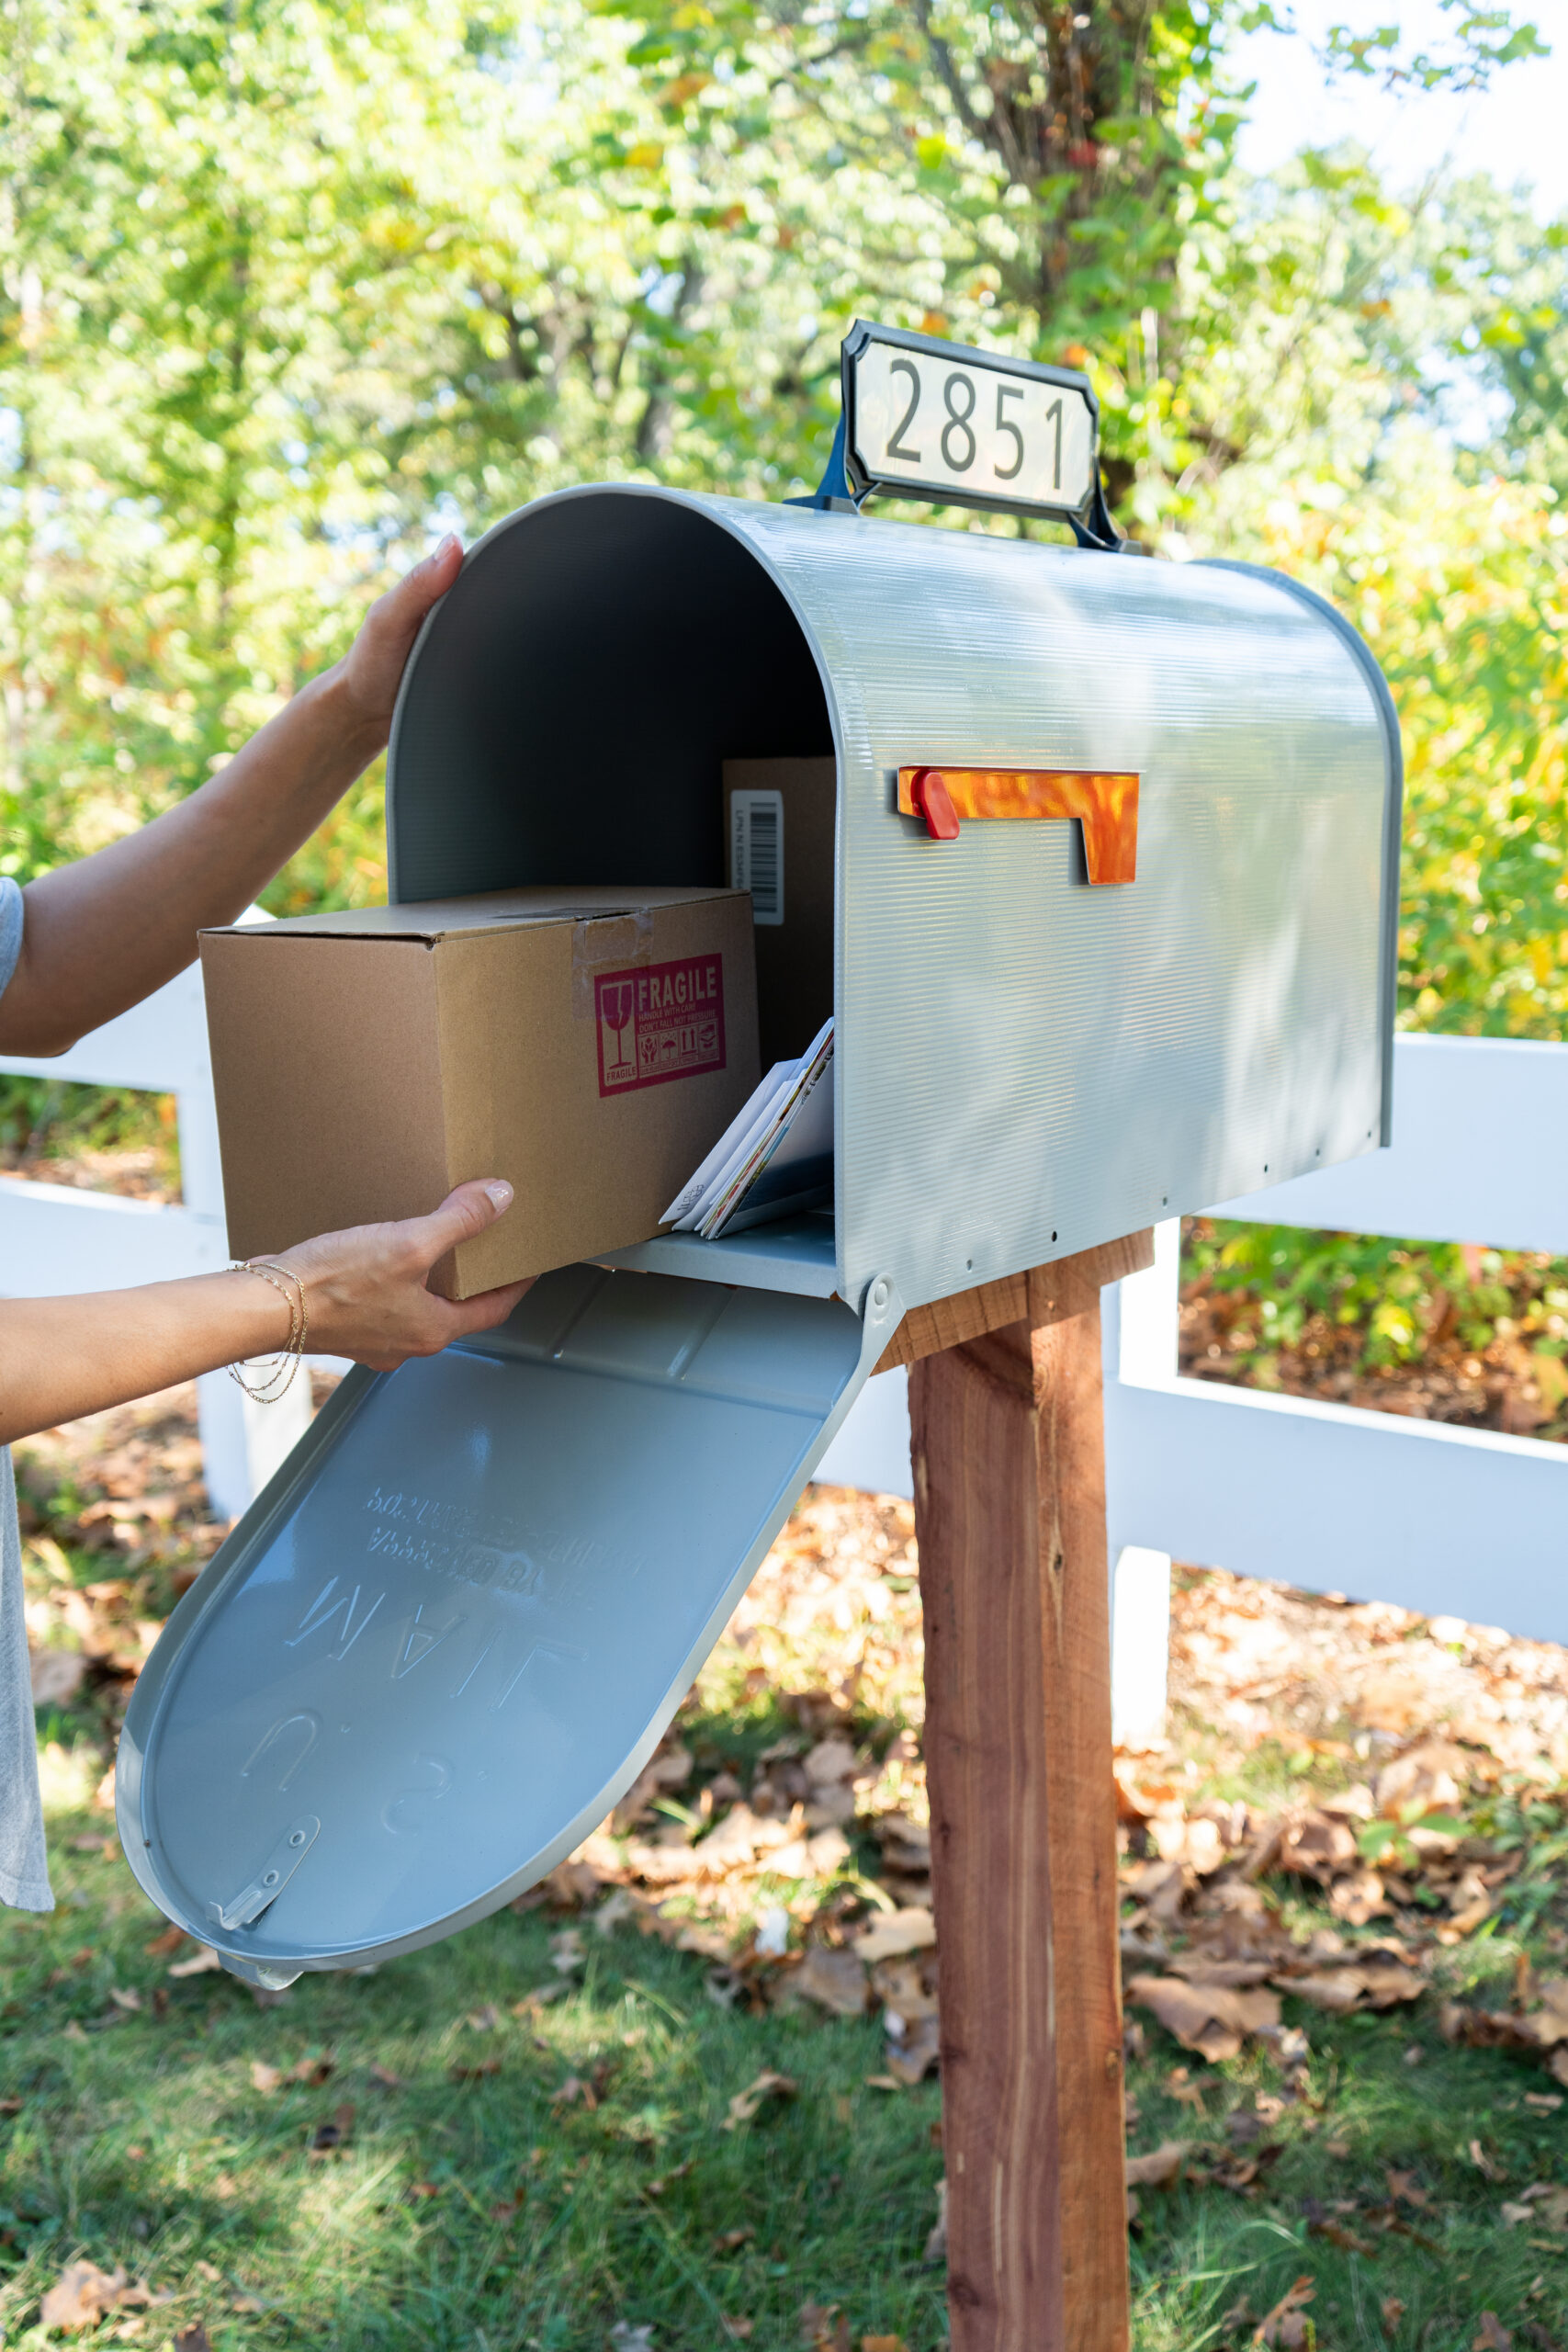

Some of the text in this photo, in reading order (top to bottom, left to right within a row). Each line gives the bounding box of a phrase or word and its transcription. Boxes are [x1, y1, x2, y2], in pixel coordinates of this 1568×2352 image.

[886, 357, 1064, 490] 2851
[638, 967, 717, 1012] FRAGILE
[638, 1002, 696, 1023] HANDLE WITH CARE
[638, 1009, 716, 1034] DON'T FALL NOT PRESSURE
[606, 1066, 637, 1082] FRAGILE
